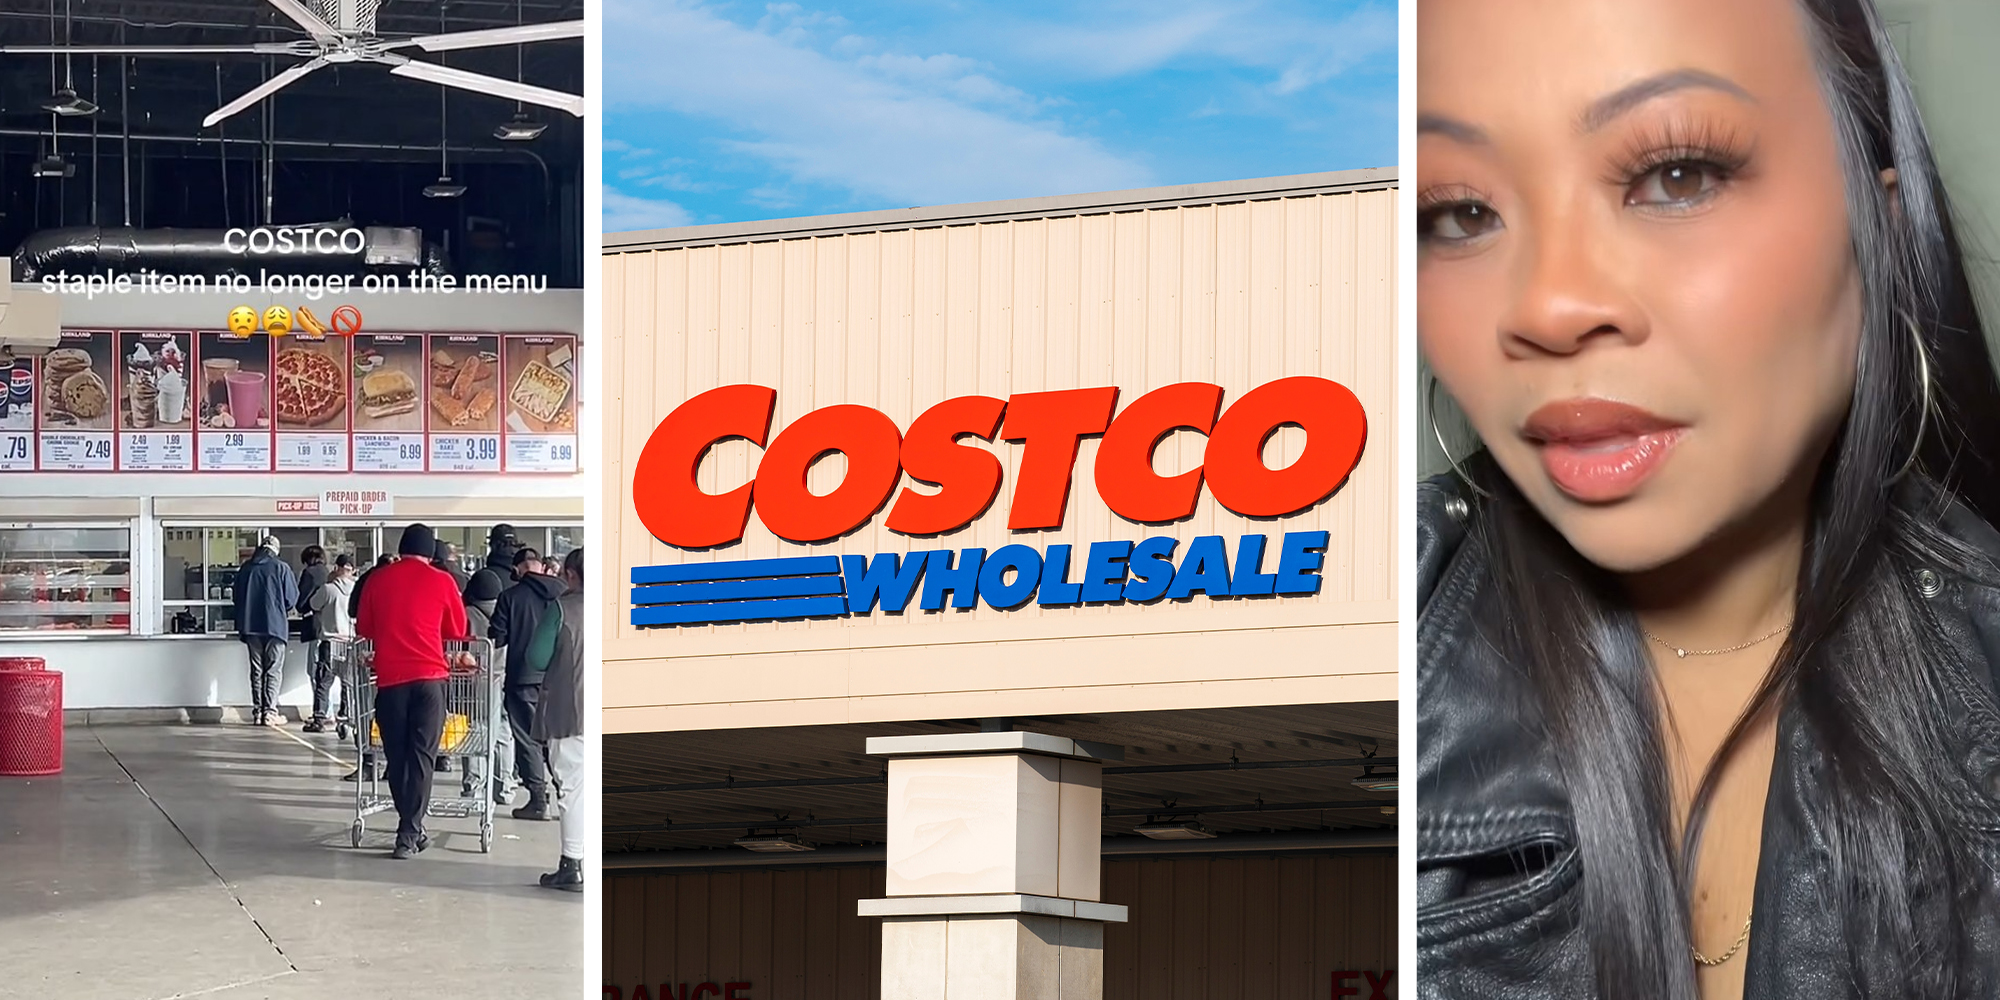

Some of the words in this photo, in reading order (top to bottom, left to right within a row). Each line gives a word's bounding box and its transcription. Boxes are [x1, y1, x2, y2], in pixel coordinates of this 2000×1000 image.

[225, 433, 244, 447] 2.99
[85, 440, 110, 458] 2.49
[400, 444, 422, 460] 6.99
[466, 438, 497, 460] 3.99
[551, 445, 572, 461] 6.99
[632, 376, 1368, 550] COSTCO
[326, 491, 359, 502] PREPAID
[361, 491, 386, 502] ORDER
[278, 502, 302, 510] PICK-UP
[340, 503, 373, 514] PICK-UP
[842, 531, 1330, 615] WHOLESALE
